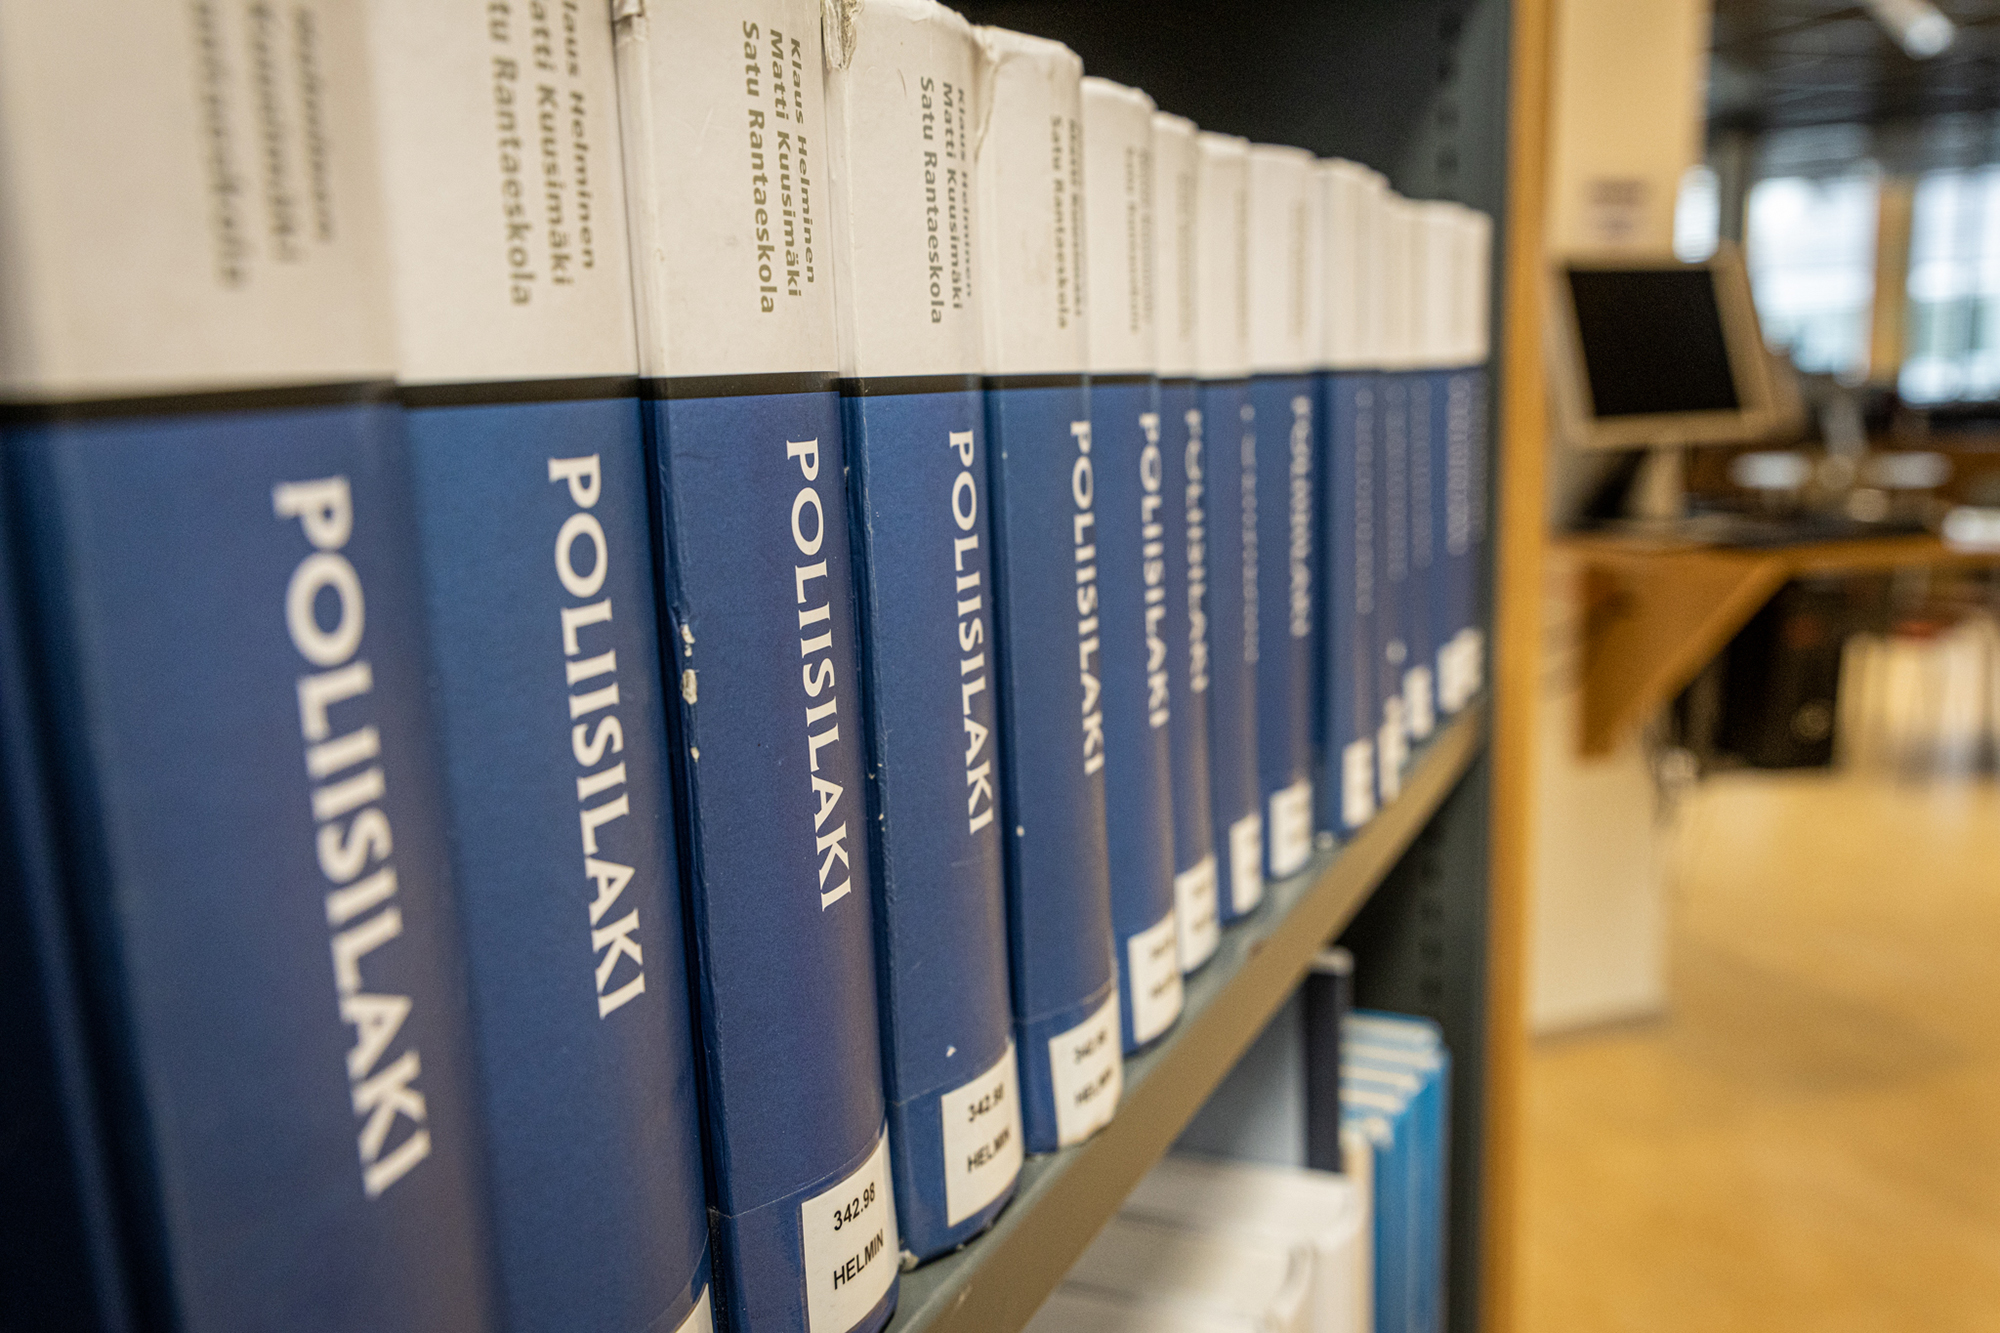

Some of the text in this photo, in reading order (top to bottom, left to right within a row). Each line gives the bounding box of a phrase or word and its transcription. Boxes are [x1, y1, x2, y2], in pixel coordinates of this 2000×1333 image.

[487, 0, 536, 306] tu Rantaeskola
[530, 0, 575, 285] atti Kuusimäki
[563, 0, 594, 269] laus Helminen
[742, 19, 778, 314] Satu Rantaeskola
[769, 28, 803, 297] Matti Kuusimäki
[790, 37, 815, 284] Klaus Helminen
[920, 75, 946, 325] Satu Rantaeskola
[942, 81, 965, 310] Matti Kuusimäki
[786, 437, 852, 912] POLIISILAKI
[949, 430, 994, 835] POLIISILAKI
[1069, 420, 1105, 776] POLIISILAKI
[1139, 412, 1170, 728] POLIISILAKI
[271, 475, 432, 1199] POLIISILAKI
[547, 454, 646, 1019] POLIISILAKI
[833, 1181, 876, 1232] 342.98
[833, 1229, 884, 1290] HELMIN
